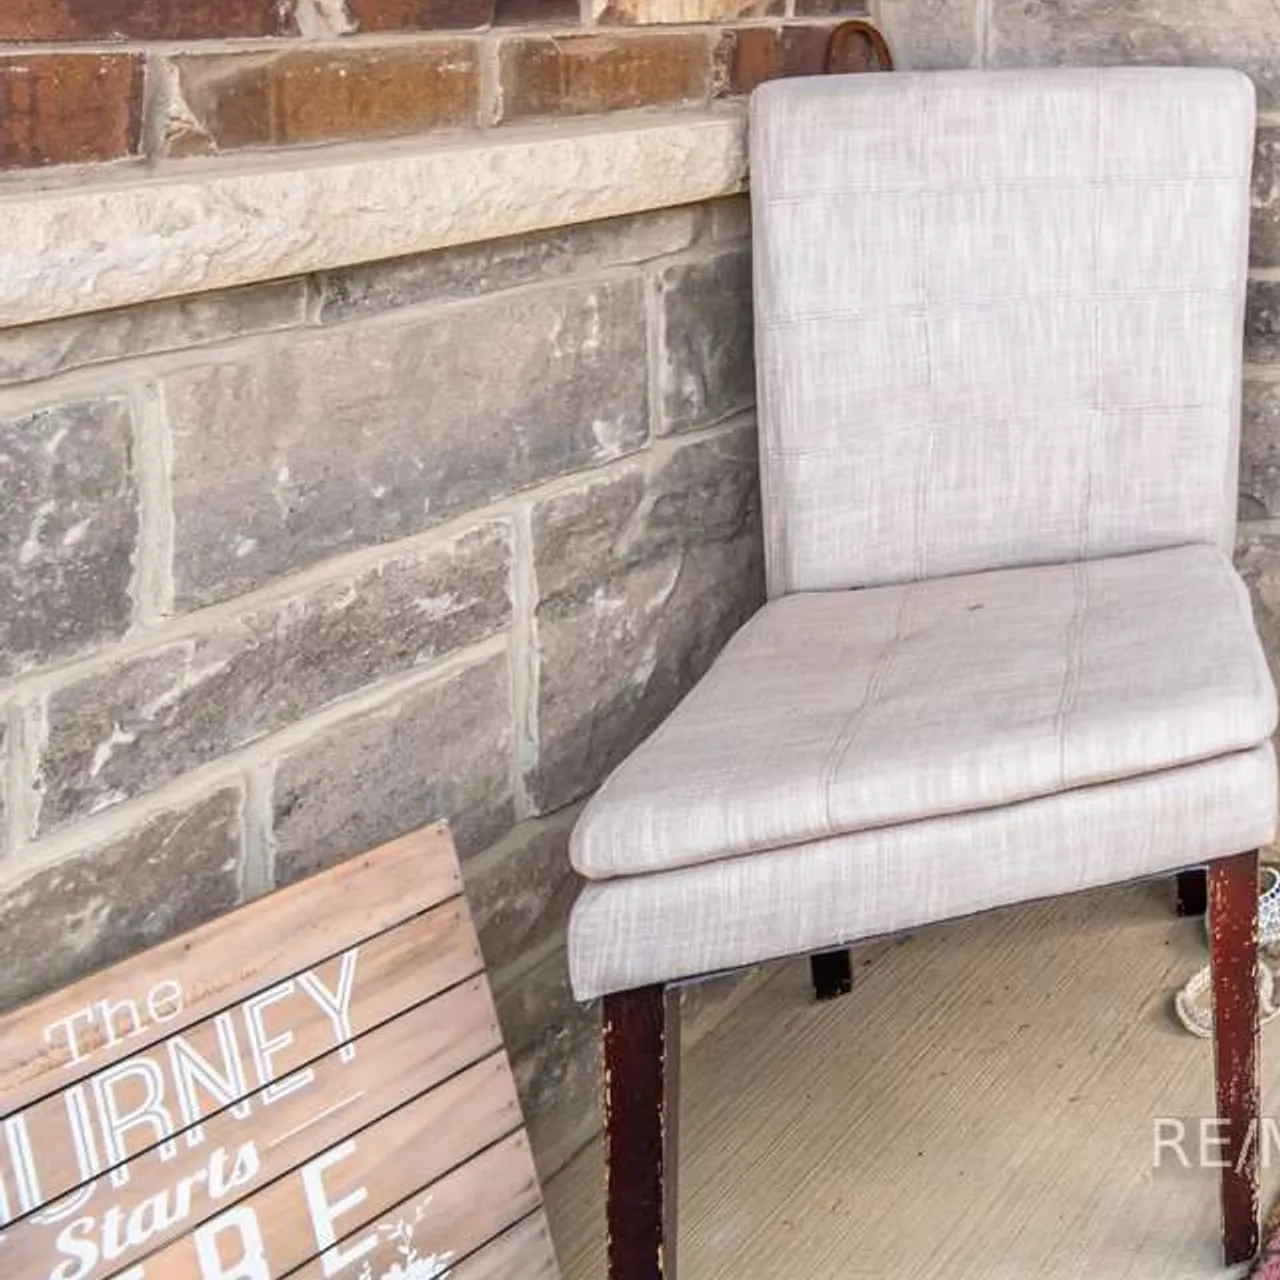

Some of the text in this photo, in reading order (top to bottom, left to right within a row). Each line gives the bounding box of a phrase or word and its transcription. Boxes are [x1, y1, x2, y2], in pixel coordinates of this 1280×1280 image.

[0, 948, 358, 1240] URNEY
[44, 979, 183, 1069] The
[48, 1140, 260, 1280] Starts
